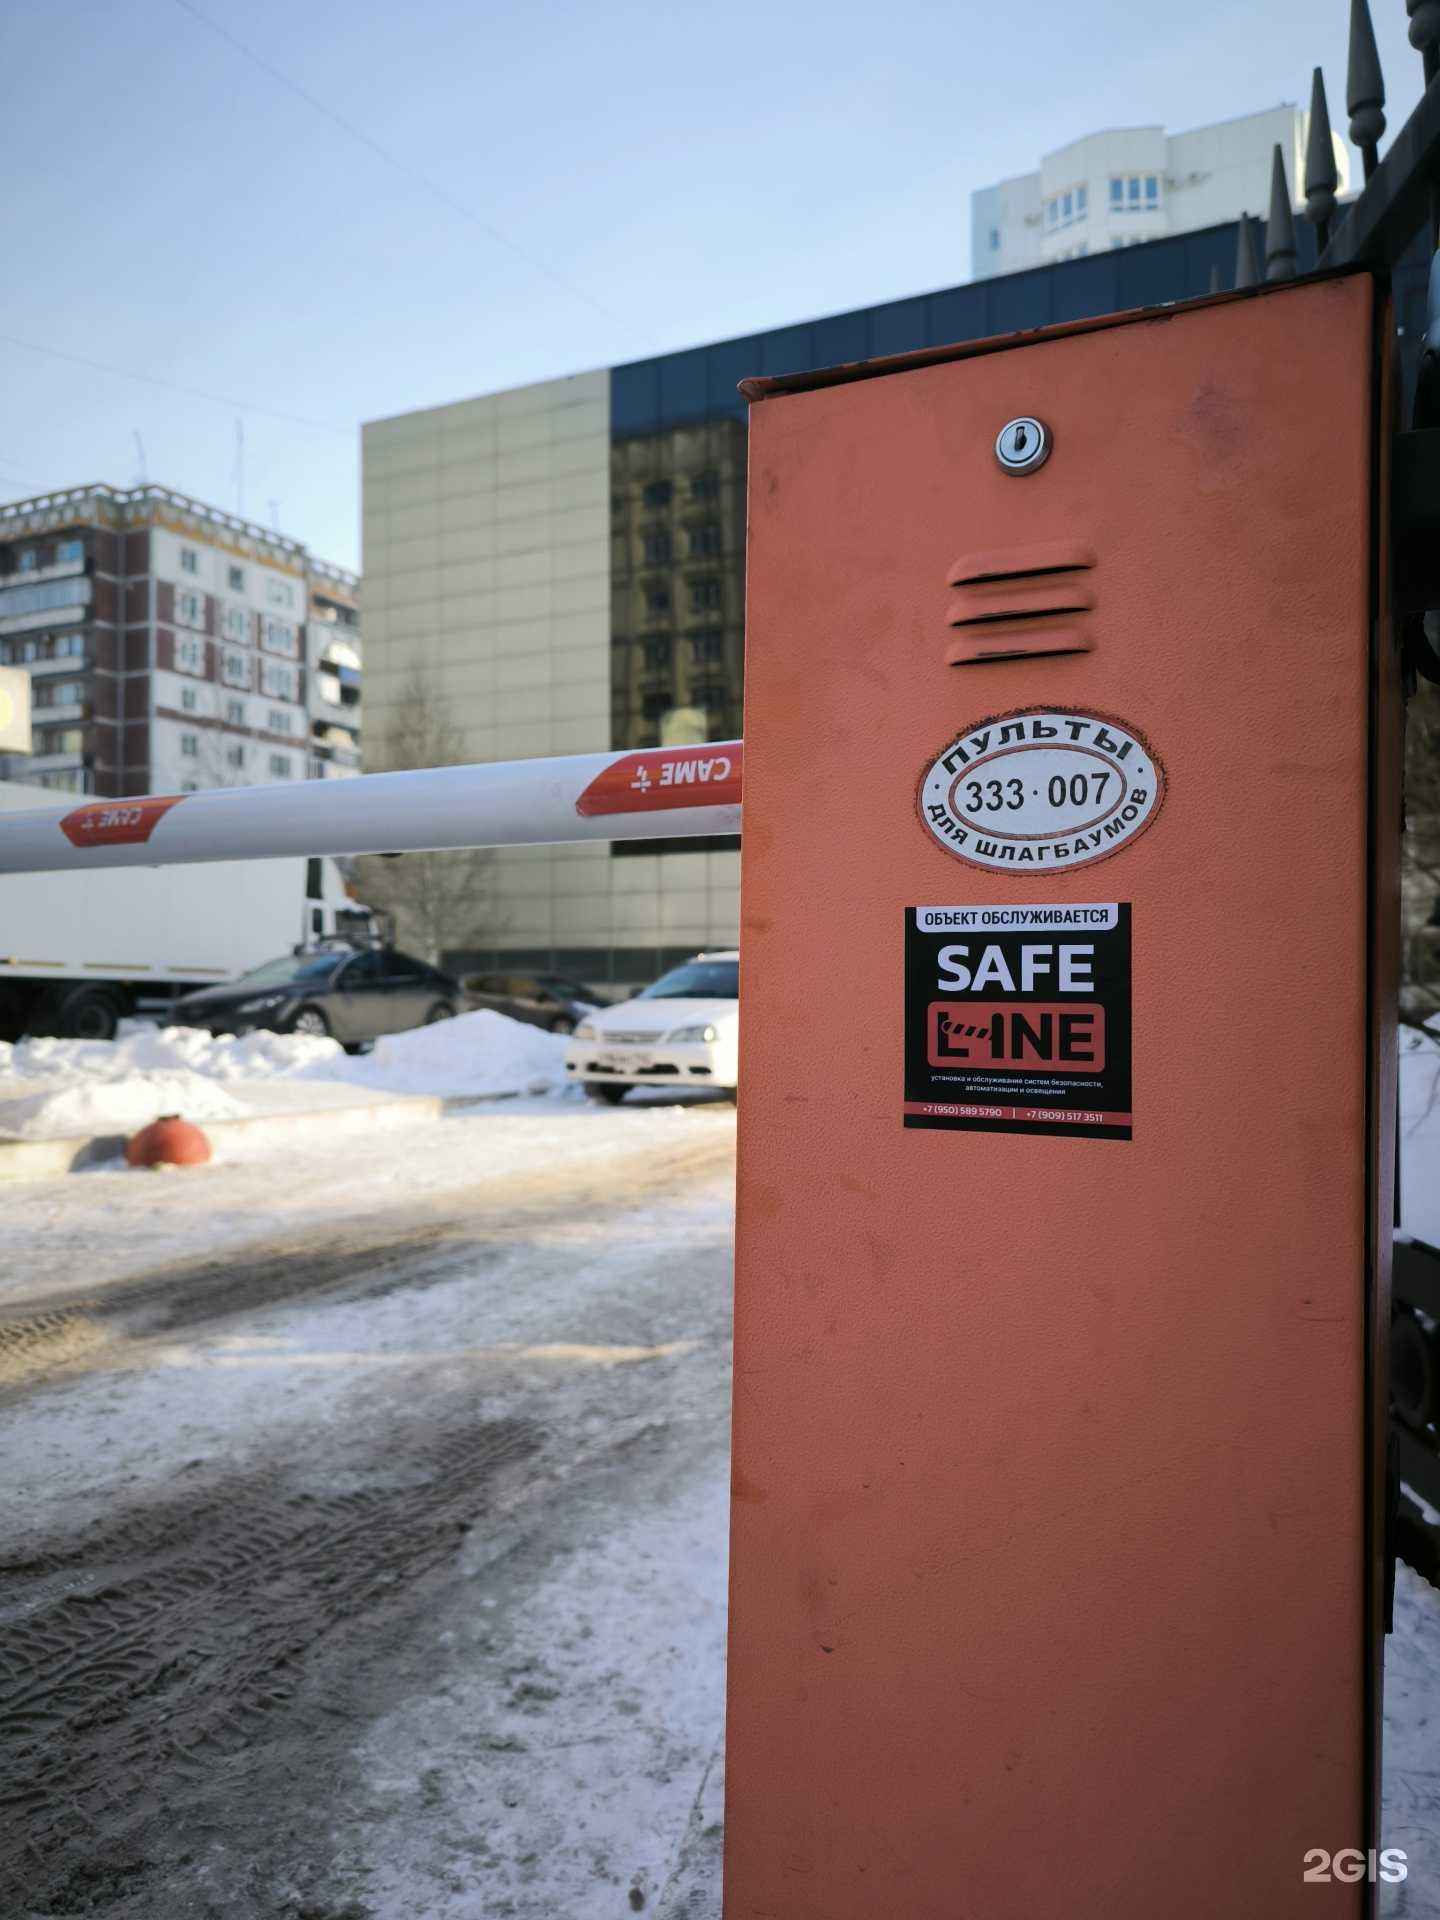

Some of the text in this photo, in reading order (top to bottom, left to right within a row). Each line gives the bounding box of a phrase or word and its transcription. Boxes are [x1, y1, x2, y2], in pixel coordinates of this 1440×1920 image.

[941, 720, 1133, 775] ПУЛЬТЫ
[659, 757, 731, 786] CAME
[928, 788, 1148, 861] ДЛЯ ШЛАГБАУМОВ
[925, 909, 1109, 926] ОБЪЕКТ ОБСЛУЖИВАЕТСЯ
[937, 944, 1095, 992] SAFE
[937, 1011, 1095, 1062] LINE
[930, 1074, 965, 1082] установка
[960, 1106, 978, 1115] 589
[1066, 1112, 1082, 1120] 517
[1083, 1113, 1103, 1122] 3511
